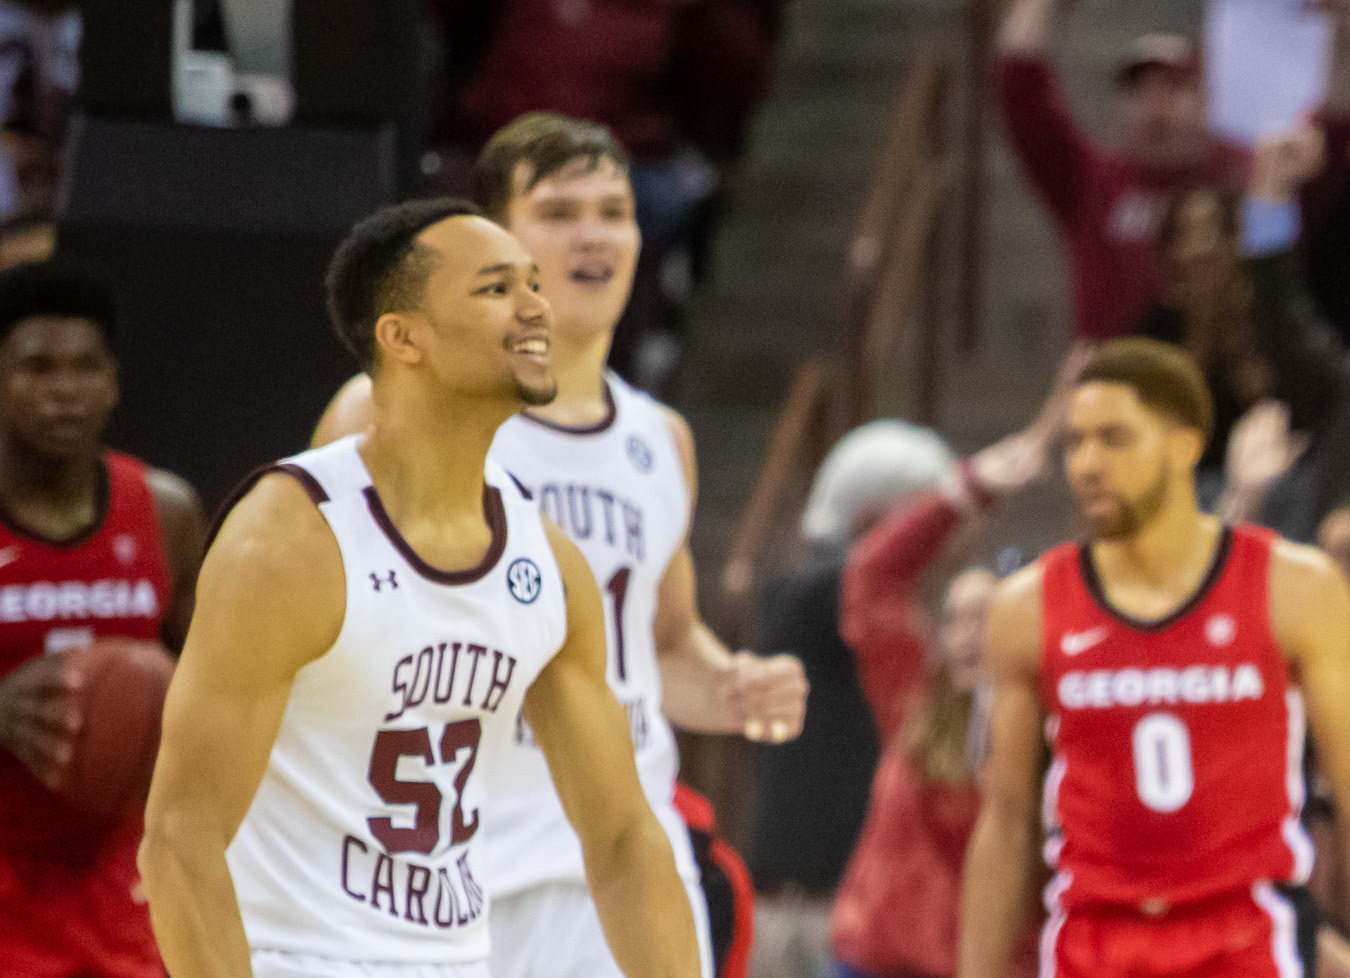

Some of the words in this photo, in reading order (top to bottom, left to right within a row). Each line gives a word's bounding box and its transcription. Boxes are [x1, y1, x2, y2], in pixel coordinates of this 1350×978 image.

[538, 482, 646, 563] OUTH
[0, 579, 158, 622] EORGIA
[383, 642, 517, 722] SOUTH
[1057, 663, 1264, 709] GEORGIA
[366, 716, 483, 857] 52
[1132, 712, 1195, 814] 0
